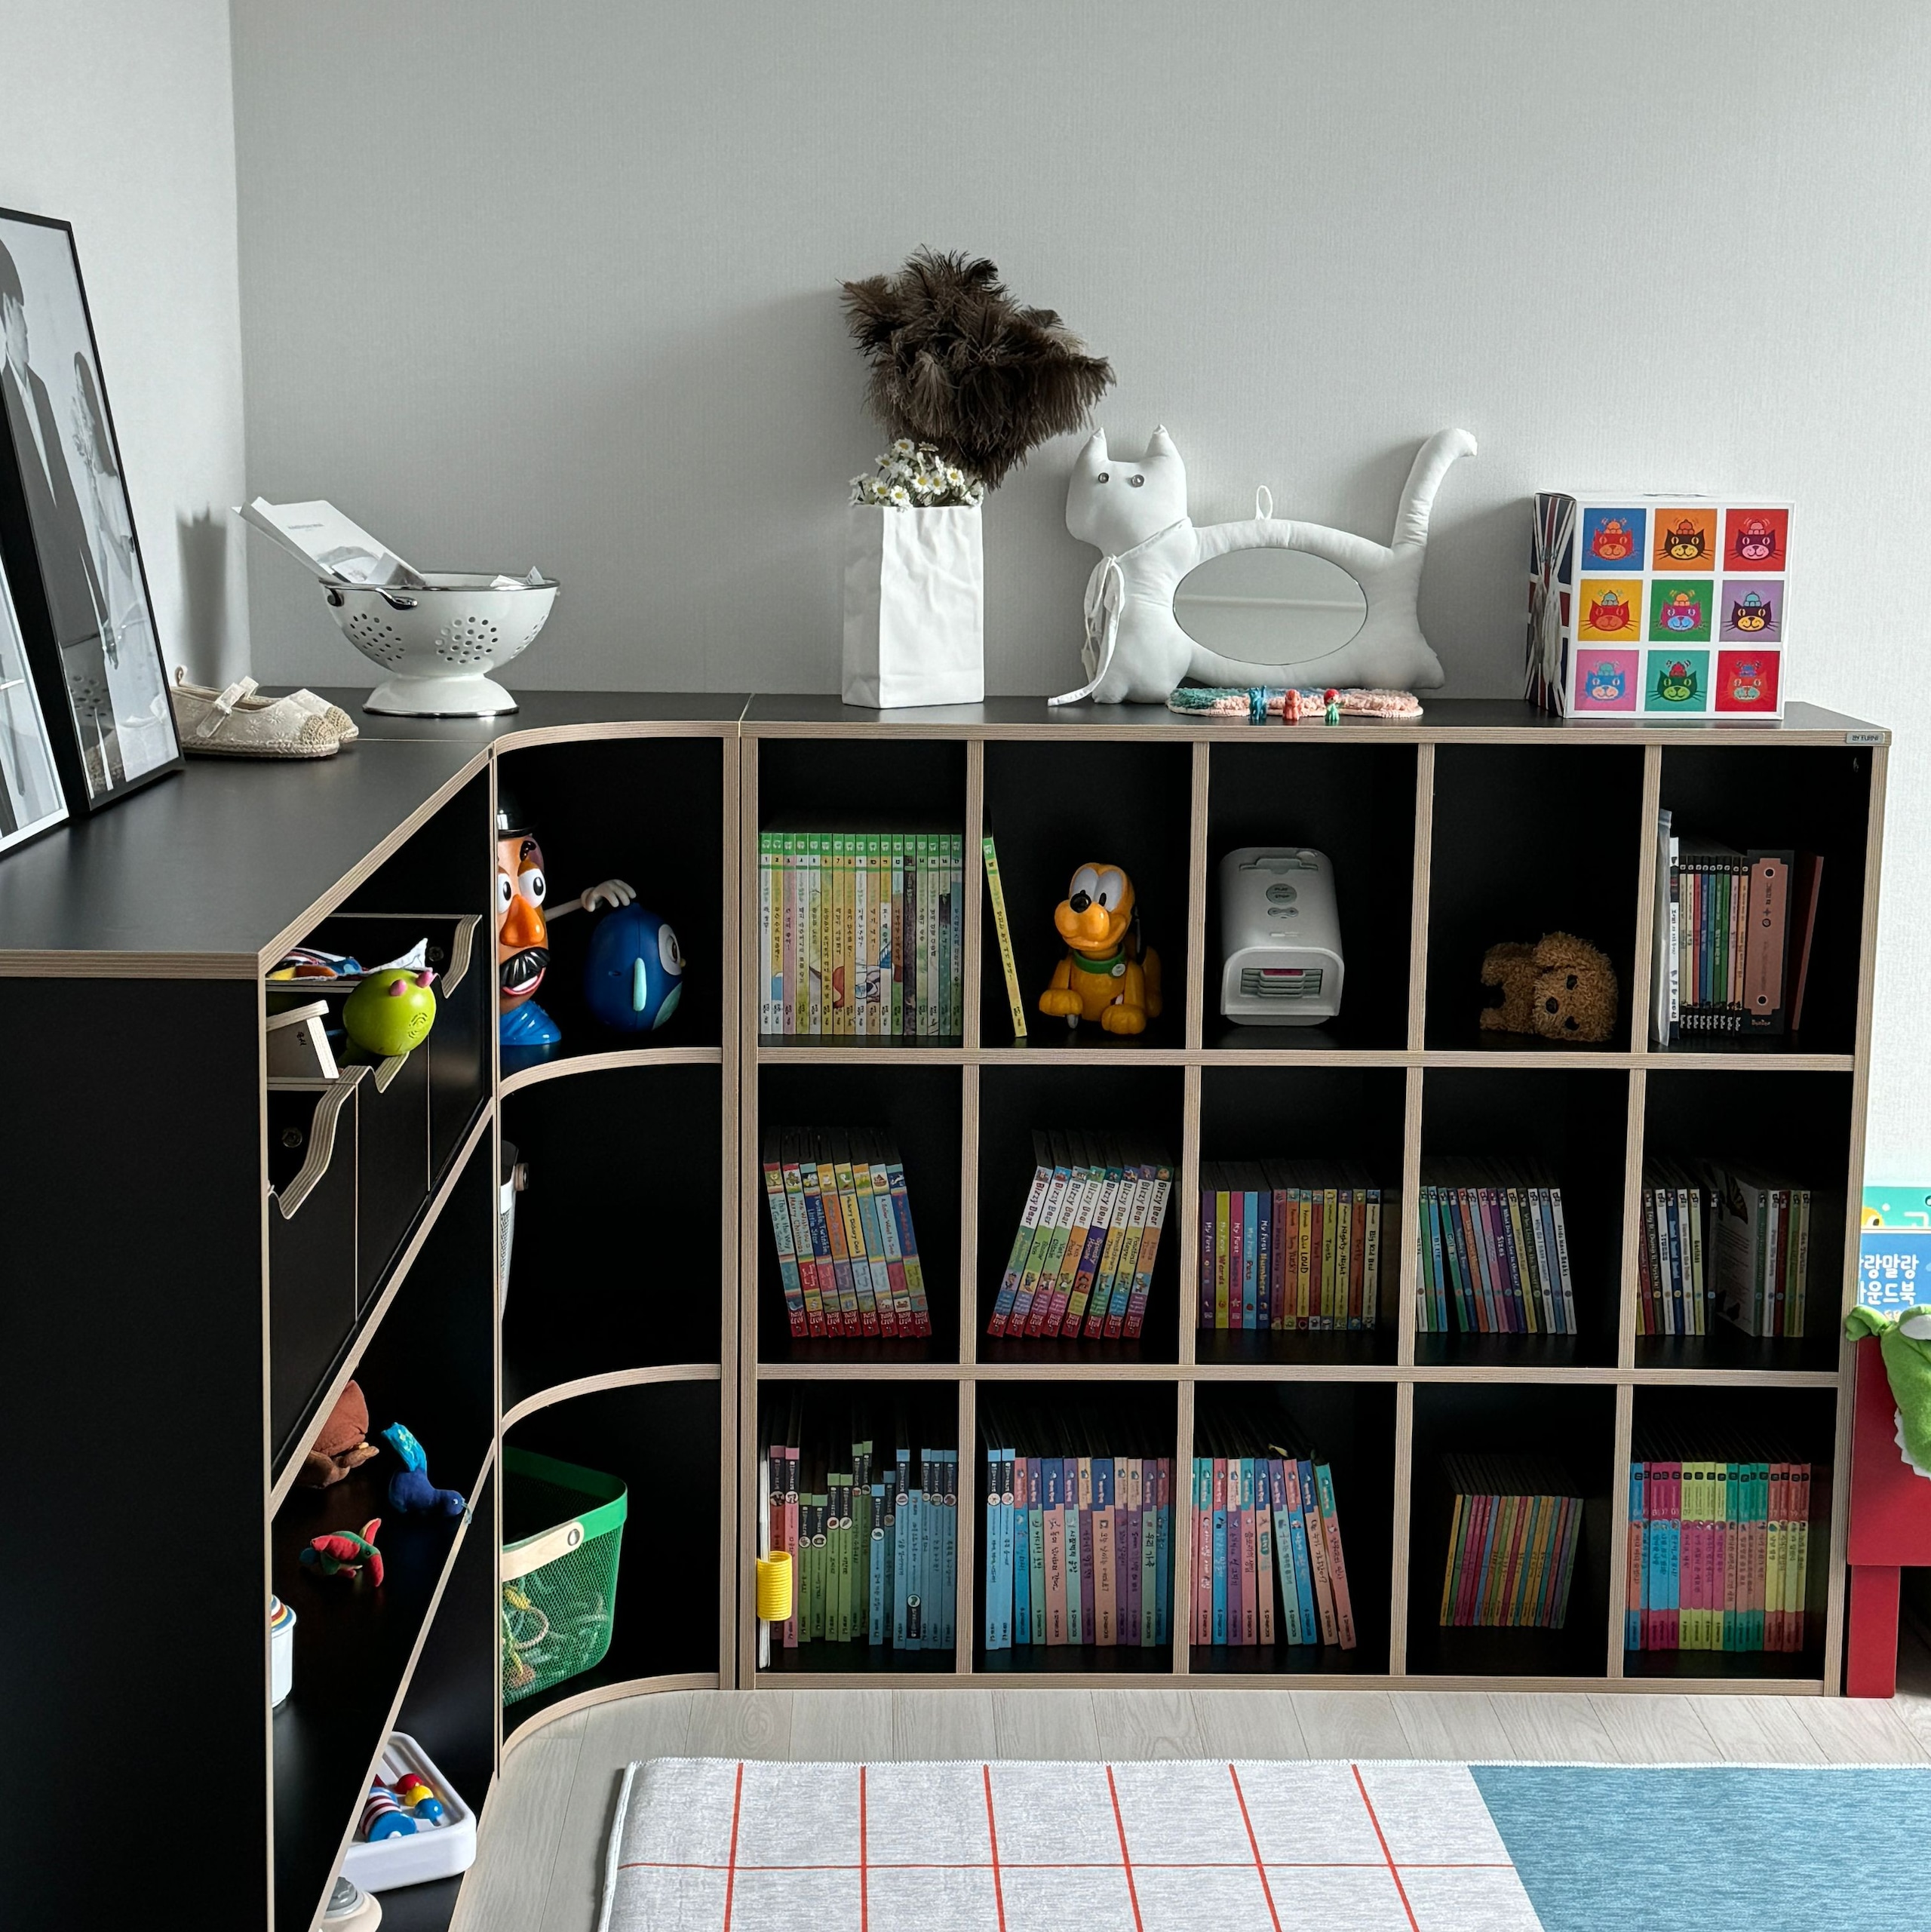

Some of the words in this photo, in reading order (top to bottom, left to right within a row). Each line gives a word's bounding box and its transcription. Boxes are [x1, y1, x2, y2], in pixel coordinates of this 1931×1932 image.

[1030, 1182, 1045, 1206] Bizzy
[1048, 1182, 1064, 1206] Bizzy
[1066, 1182, 1082, 1206] Bizzy
[1083, 1182, 1099, 1206] Bizzy
[1100, 1182, 1116, 1206] Bizzy
[1118, 1182, 1133, 1206] Bizzy
[1135, 1181, 1151, 1206] Bizzy
[1153, 1181, 1168, 1206] Bizzy
[1024, 1206, 1039, 1226] Bear
[1043, 1206, 1057, 1226] Bear
[1061, 1206, 1074, 1227] Bear
[1079, 1206, 1091, 1226] Bear
[1095, 1206, 1109, 1226] Bear
[1114, 1206, 1126, 1227] Bear
[1132, 1205, 1145, 1226] Bear
[1149, 1206, 1162, 1226] Bear
[1300, 1252, 1309, 1273] LOUD
[1859, 1254, 1920, 1279] 랑말랑
[1259, 1253, 1267, 1296] Numbers
[1145, 1533, 1154, 1547] 우리
[1145, 1551, 1155, 1568] 가족
